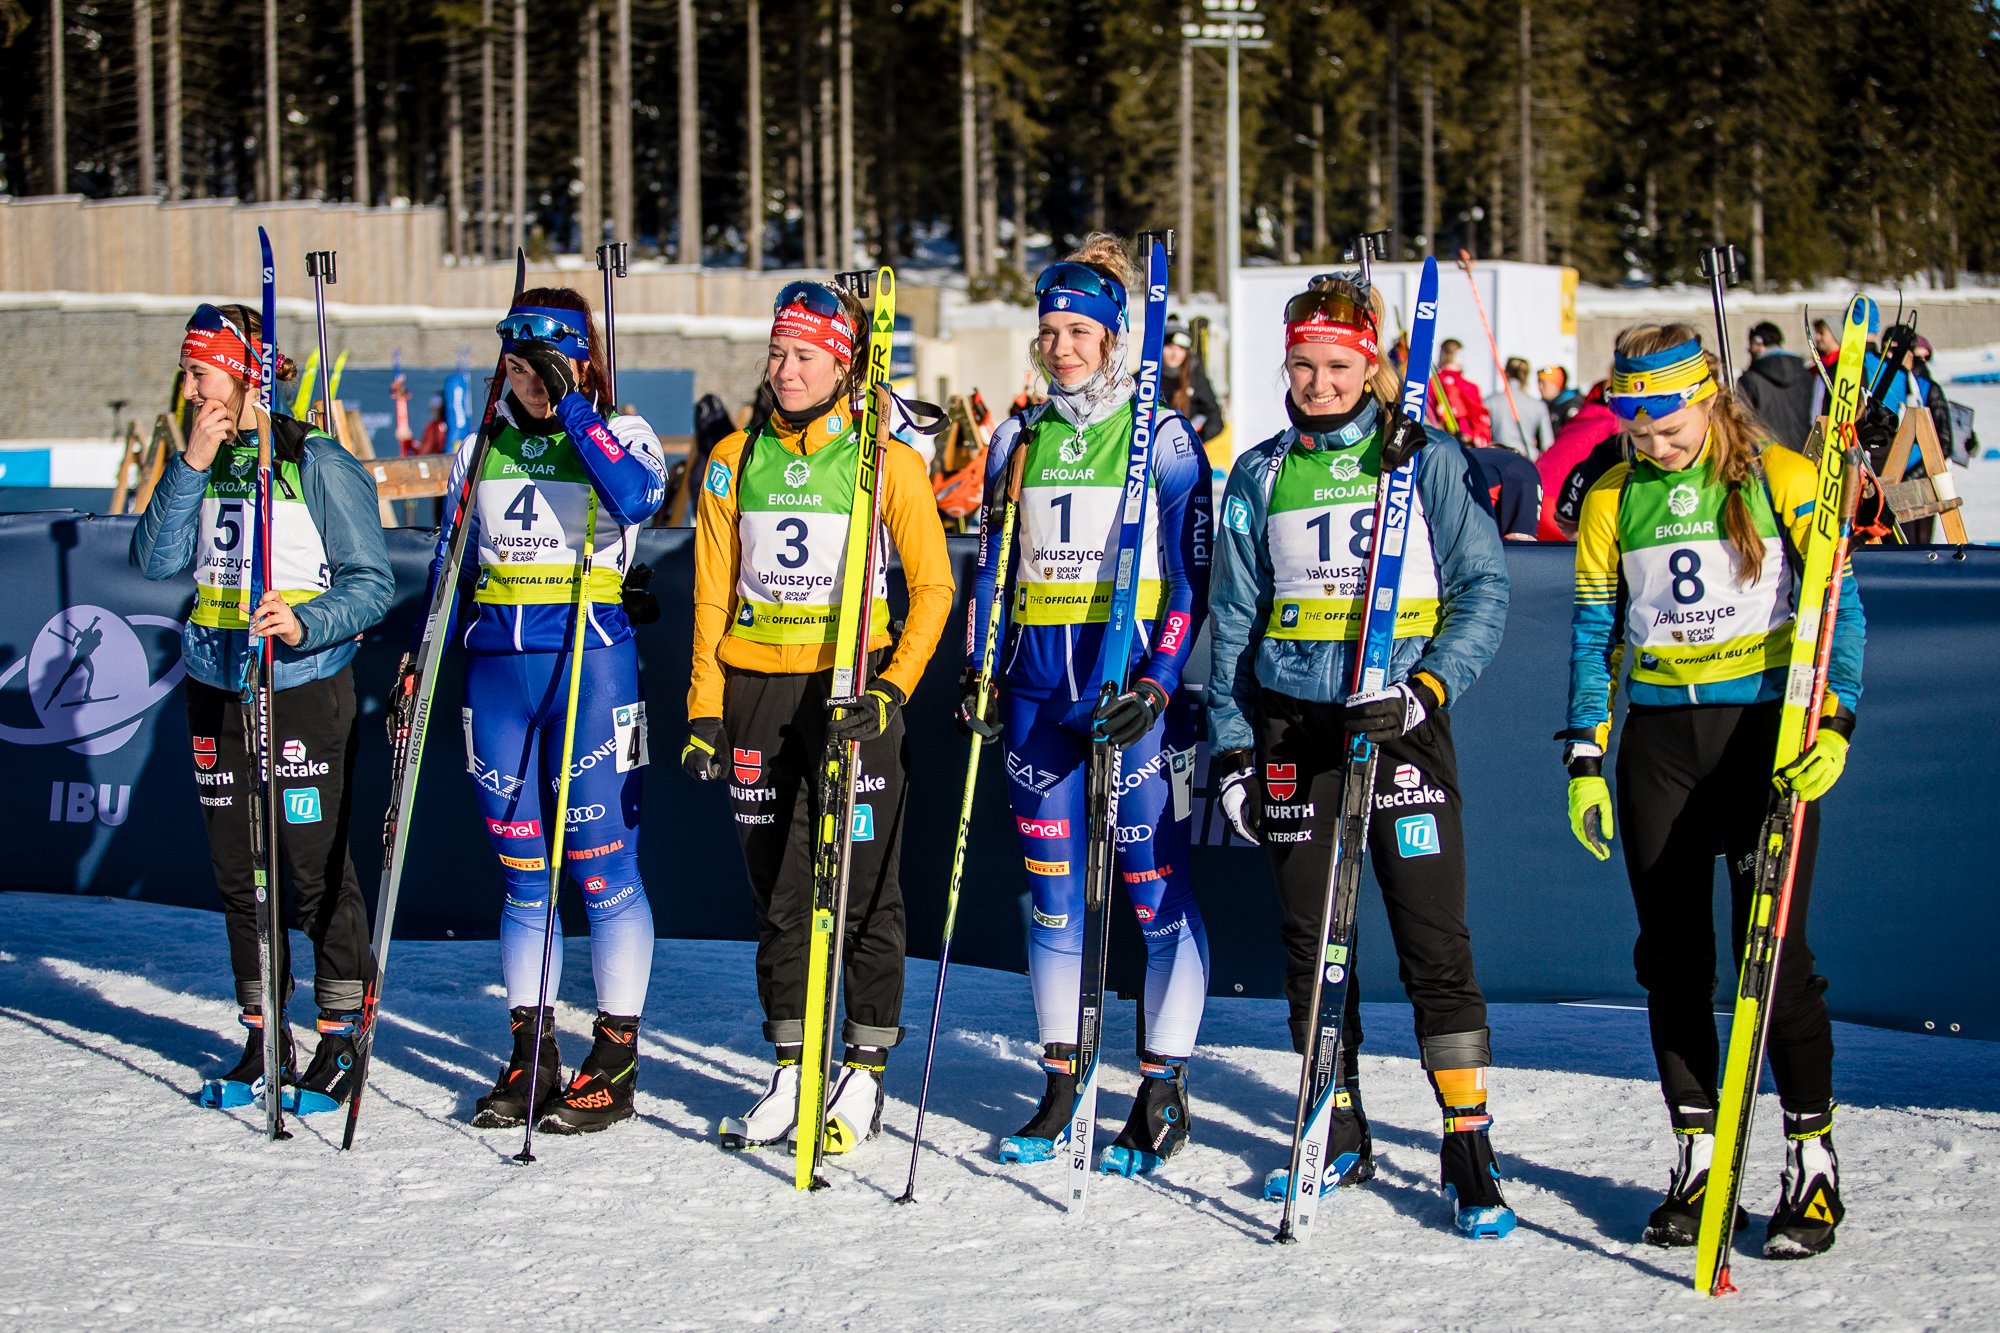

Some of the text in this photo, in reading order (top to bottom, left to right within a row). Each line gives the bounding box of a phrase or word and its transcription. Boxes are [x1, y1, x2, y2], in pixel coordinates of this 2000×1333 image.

[1127, 360, 1159, 500] SALOMON
[591, 426, 621, 457] enel
[502, 463, 556, 476] EKOJAR
[1817, 377, 1855, 541] FISCHER
[1041, 467, 1095, 481] EKOJAR
[213, 481, 256, 492] EKOJAR
[1313, 485, 1379, 502] EKOJAR
[1560, 472, 1584, 517] USA
[503, 484, 539, 531] 4
[767, 493, 823, 507] EKOJAR
[213, 503, 243, 551] 5
[1050, 492, 1073, 544] 1
[977, 505, 989, 567] FALCONERI
[1194, 508, 1210, 566] Audi
[1306, 508, 1376, 563] 18
[1655, 520, 1714, 540] EKOJAR
[776, 517, 810, 569] 3
[1031, 546, 1104, 565] Jakuszyce
[545, 576, 561, 585] IBU
[564, 576, 581, 585] AP
[1056, 566, 1083, 574] DOLNY
[1305, 565, 1369, 582] Jakuszy
[1669, 548, 1705, 605] 8
[210, 598, 240, 609] OFFICIA
[1029, 595, 1110, 605] THE OFFICIAL IBU
[757, 614, 836, 626] THE OFFICIAL IBU
[1304, 611, 1322, 621] THE
[1400, 611, 1421, 620] APP
[1653, 605, 1736, 627] Jakuszyce
[1160, 616, 1184, 651] enel
[1674, 652, 1723, 666] OFFICIAL
[1724, 648, 1744, 660] IBU
[1745, 642, 1766, 656] APP
[410, 696, 431, 766] ROSSIGNOL
[275, 760, 329, 777] ectake
[729, 783, 777, 802] WÜRTH
[1375, 784, 1446, 810] tectake
[49, 781, 131, 827] IBU
[288, 793, 316, 819] TQ
[492, 821, 536, 838] enel
[740, 813, 775, 825] TERREX
[1020, 821, 1064, 837] enel
[1273, 829, 1313, 843] TERREX
[1402, 820, 1434, 850] TQ
[567, 839, 625, 861] FINSTRAL
[1027, 860, 1065, 873] PIRELLI
[325, 1070, 346, 1093] SALOMON
[566, 1088, 614, 1109] ROSSI
[1151, 1123, 1171, 1151] SALOMON
